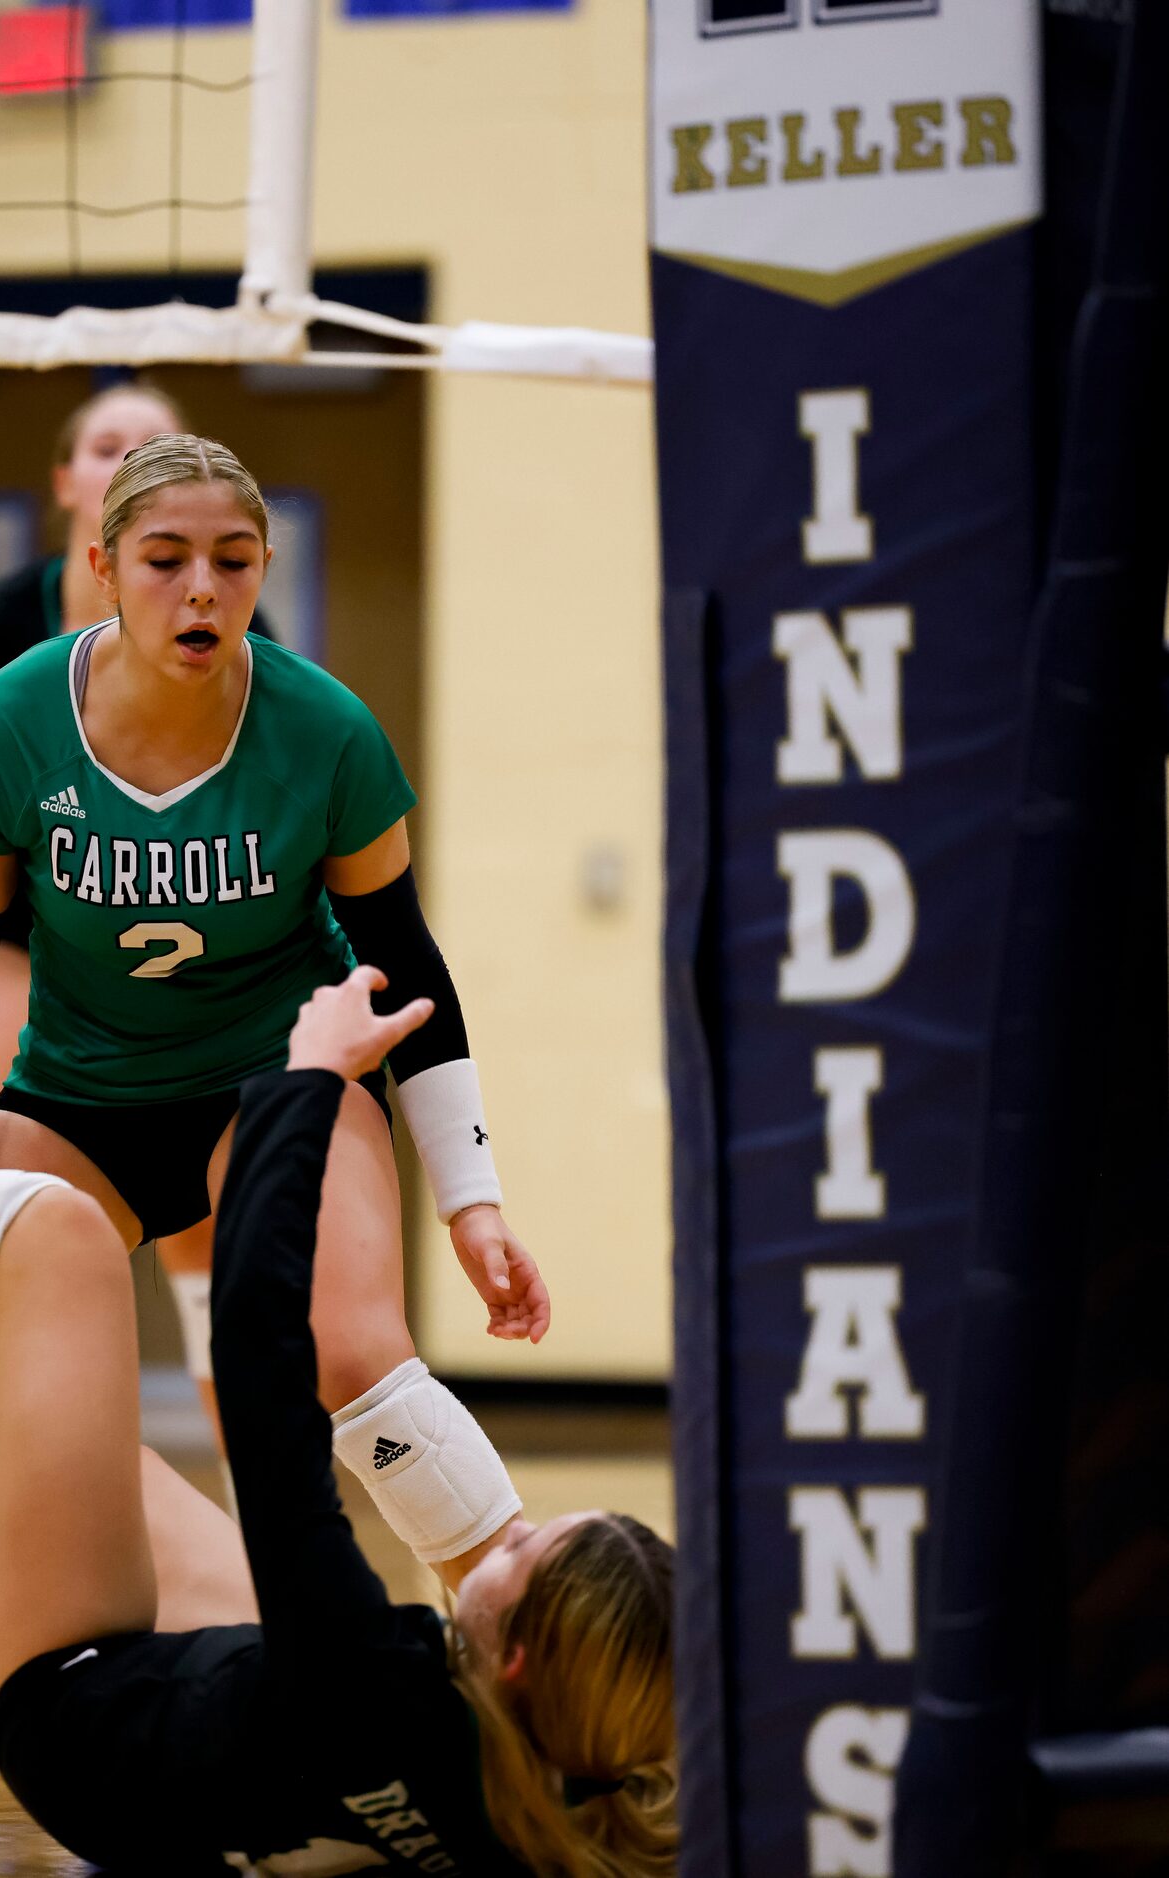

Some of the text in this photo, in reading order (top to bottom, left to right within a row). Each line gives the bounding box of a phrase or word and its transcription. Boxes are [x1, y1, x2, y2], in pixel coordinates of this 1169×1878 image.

[669, 96, 1017, 195] KELLER
[39, 799, 87, 819] adidas
[49, 825, 277, 907] CARROLL
[118, 921, 205, 979] 2
[773, 387, 926, 1878] INDIANS
[374, 1442, 412, 1470] adidas
